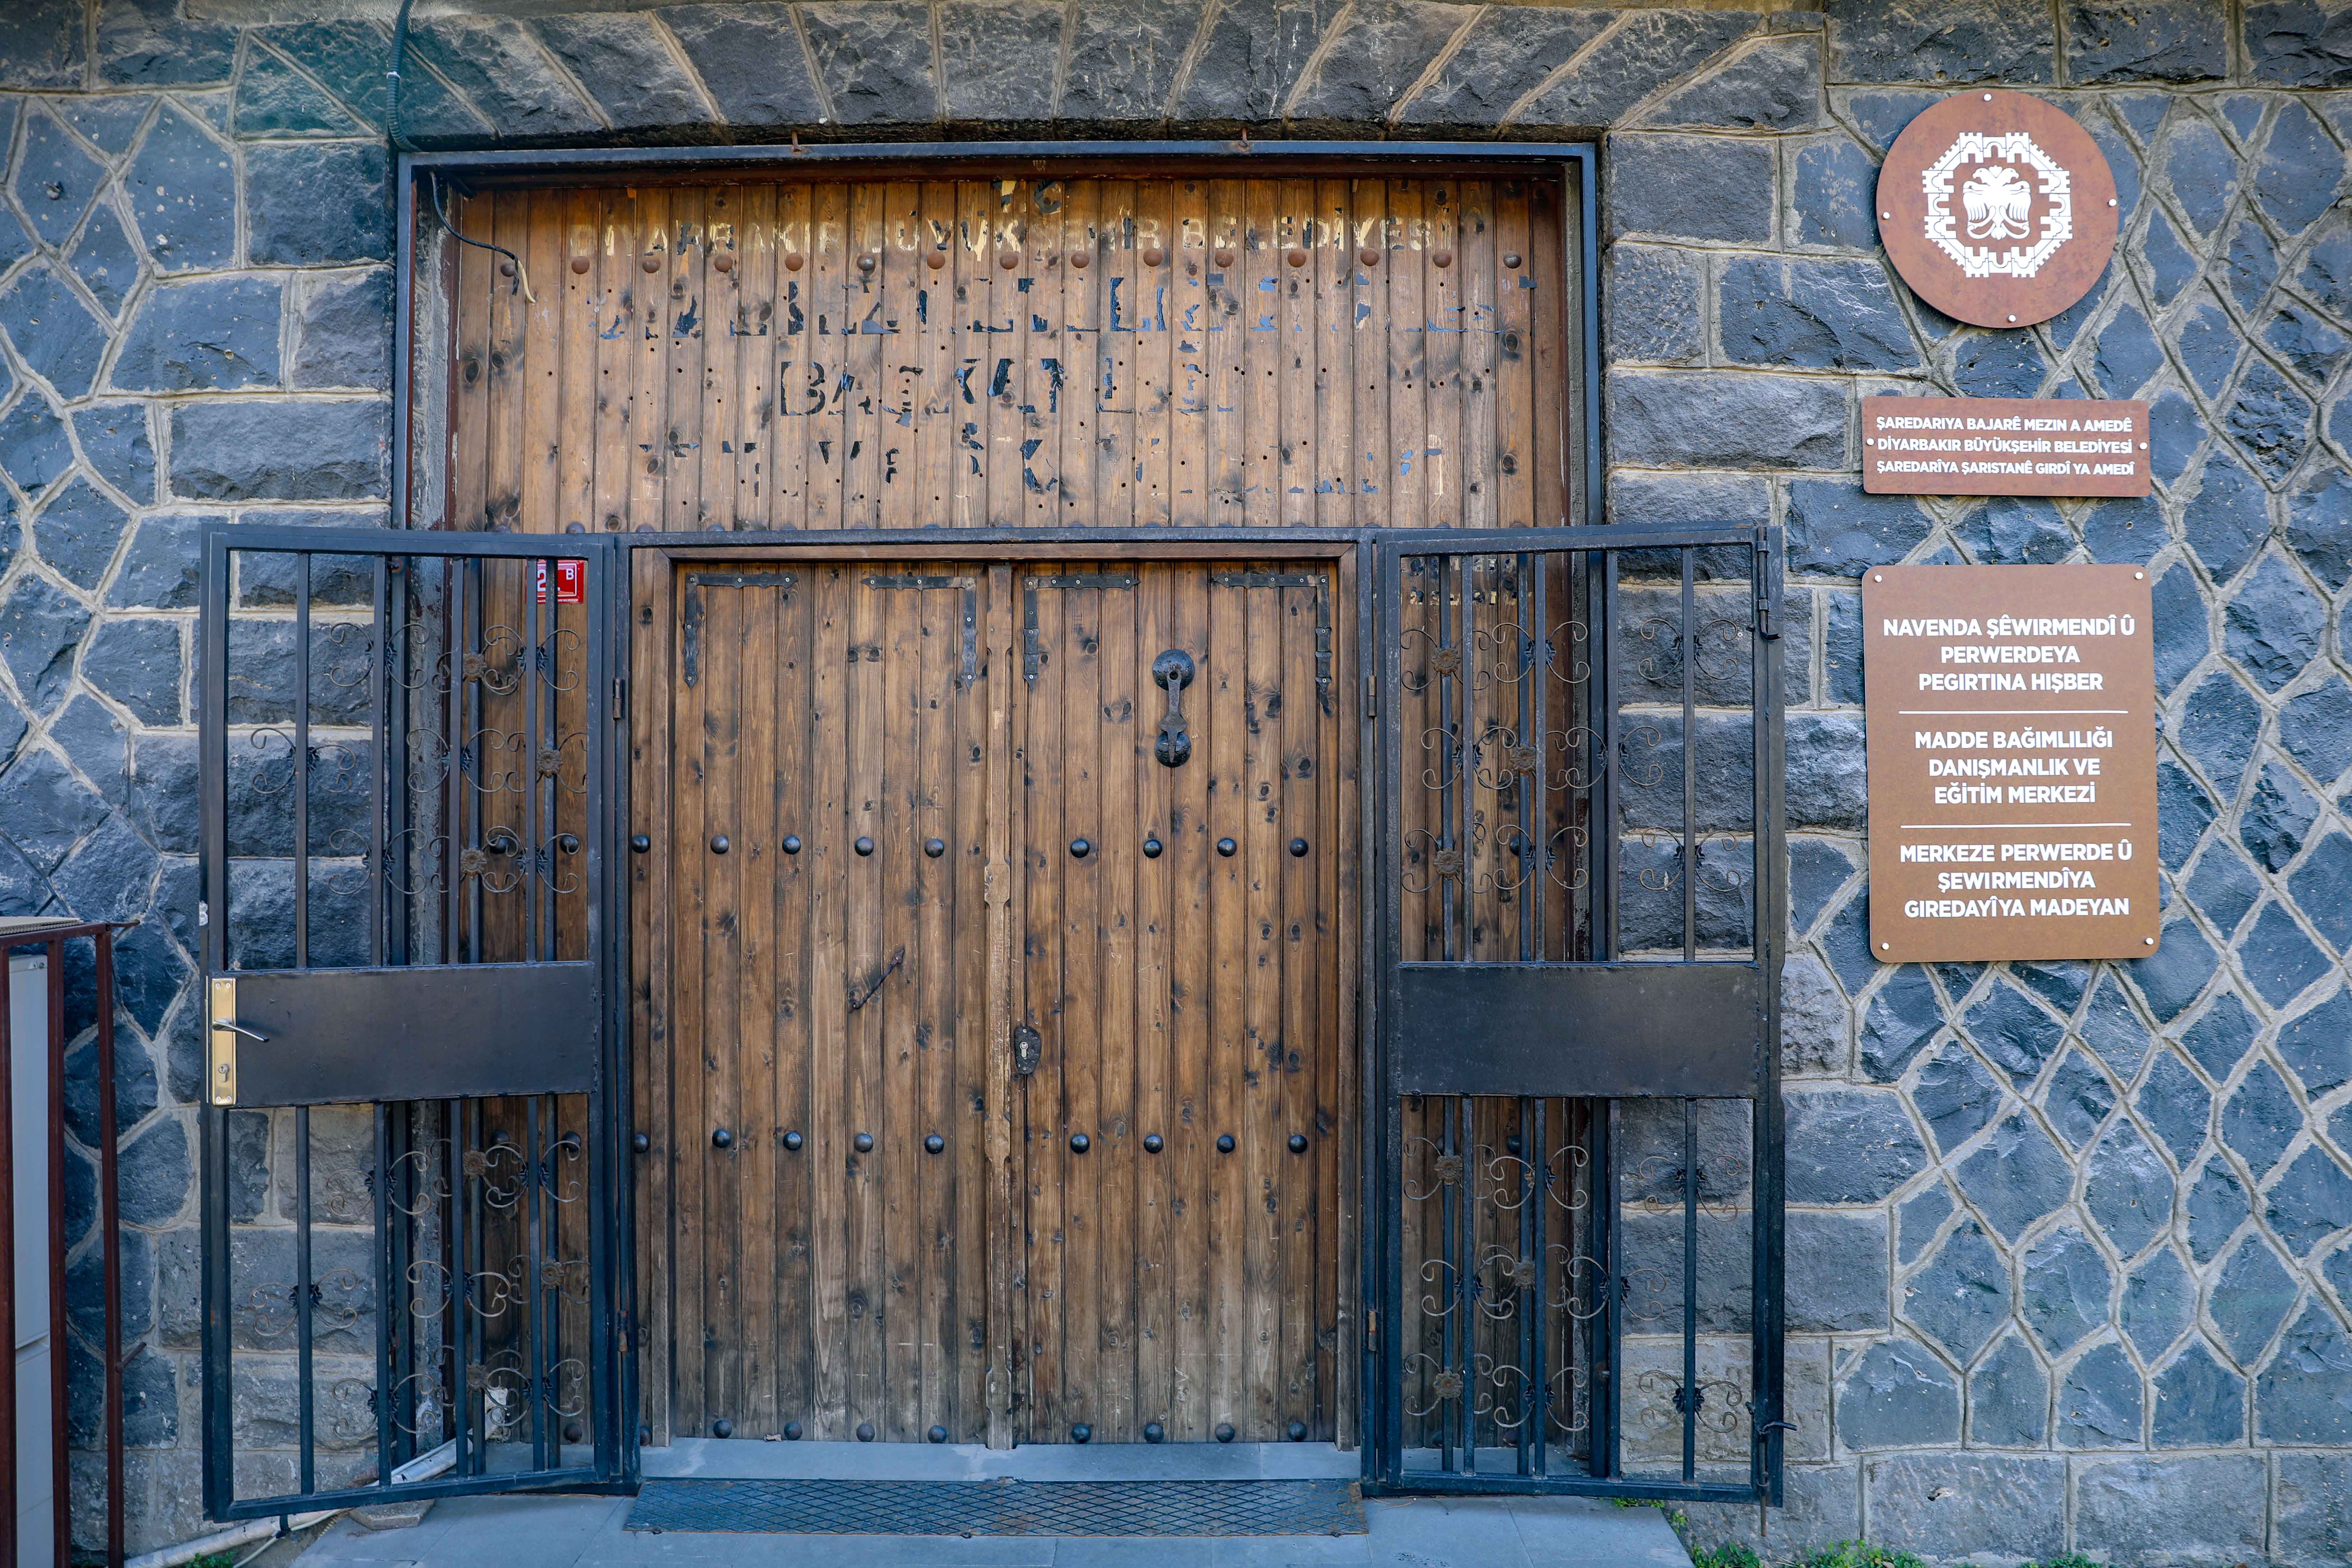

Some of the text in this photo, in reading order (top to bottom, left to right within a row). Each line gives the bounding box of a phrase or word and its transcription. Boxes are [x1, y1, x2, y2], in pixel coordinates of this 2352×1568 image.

[1876, 415, 2133, 432] ŞAREDARIYA BAJARÊ MEZIN A AMEDÊ
[1877, 435, 2133, 455] DİYARBAKIR BÜYÜKŞEHİR BELEDİYESİ
[1877, 458, 2135, 475] ŞAREDARÎYA ŞARISTANÊ GIRDÎ YA AMEDÎ
[1883, 613, 2135, 639] NAVENDA ŞÊWIRMENDÎ Û
[1940, 645, 2081, 664] PERWERDEYA
[1919, 673, 2104, 694] PEGIRTINA HIŞBER
[1915, 725, 2113, 749] MADDE BAĞIMLILIĞI
[1929, 758, 2101, 779] DANIŞMANLIK VE
[1934, 781, 2096, 804] EĞİTİM MERKEZİ
[1900, 838, 2133, 863] MERKEZE PERWERDE Û
[1937, 866, 2096, 894] ŞEWIRMENDÎYA
[1904, 895, 2130, 918] GIREDAYÎYA MADEYAN
